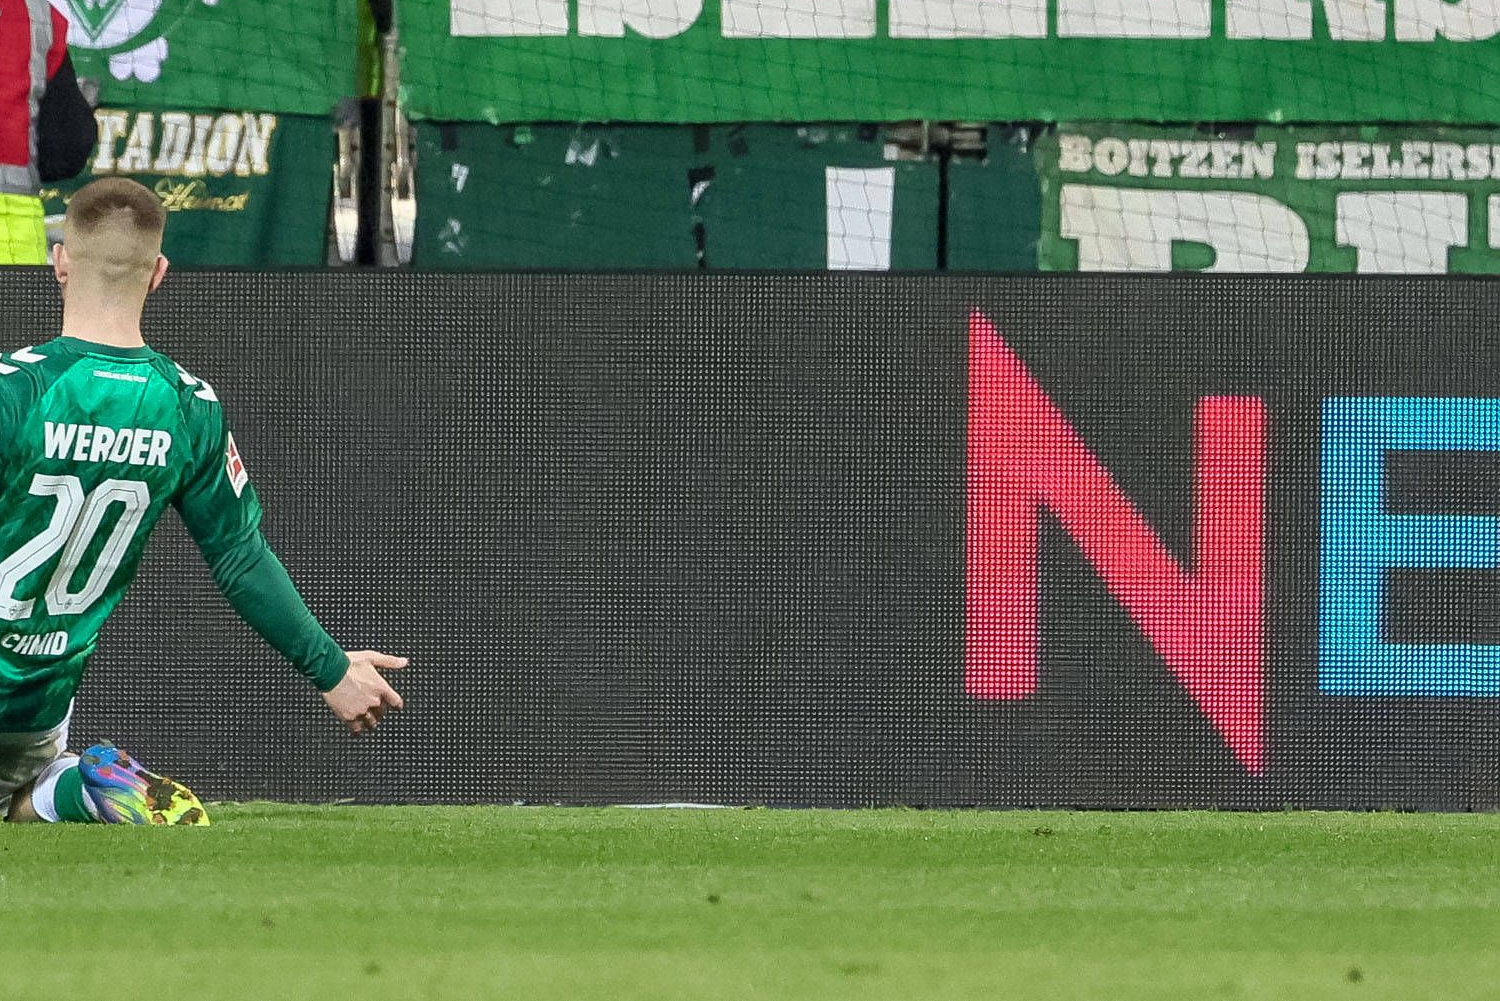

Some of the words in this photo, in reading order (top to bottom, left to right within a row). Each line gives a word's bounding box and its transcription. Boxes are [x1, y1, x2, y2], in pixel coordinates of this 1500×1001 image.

[90, 108, 278, 178] TADION
[1059, 134, 1278, 178] BOITZEN
[43, 420, 172, 467] WERDER
